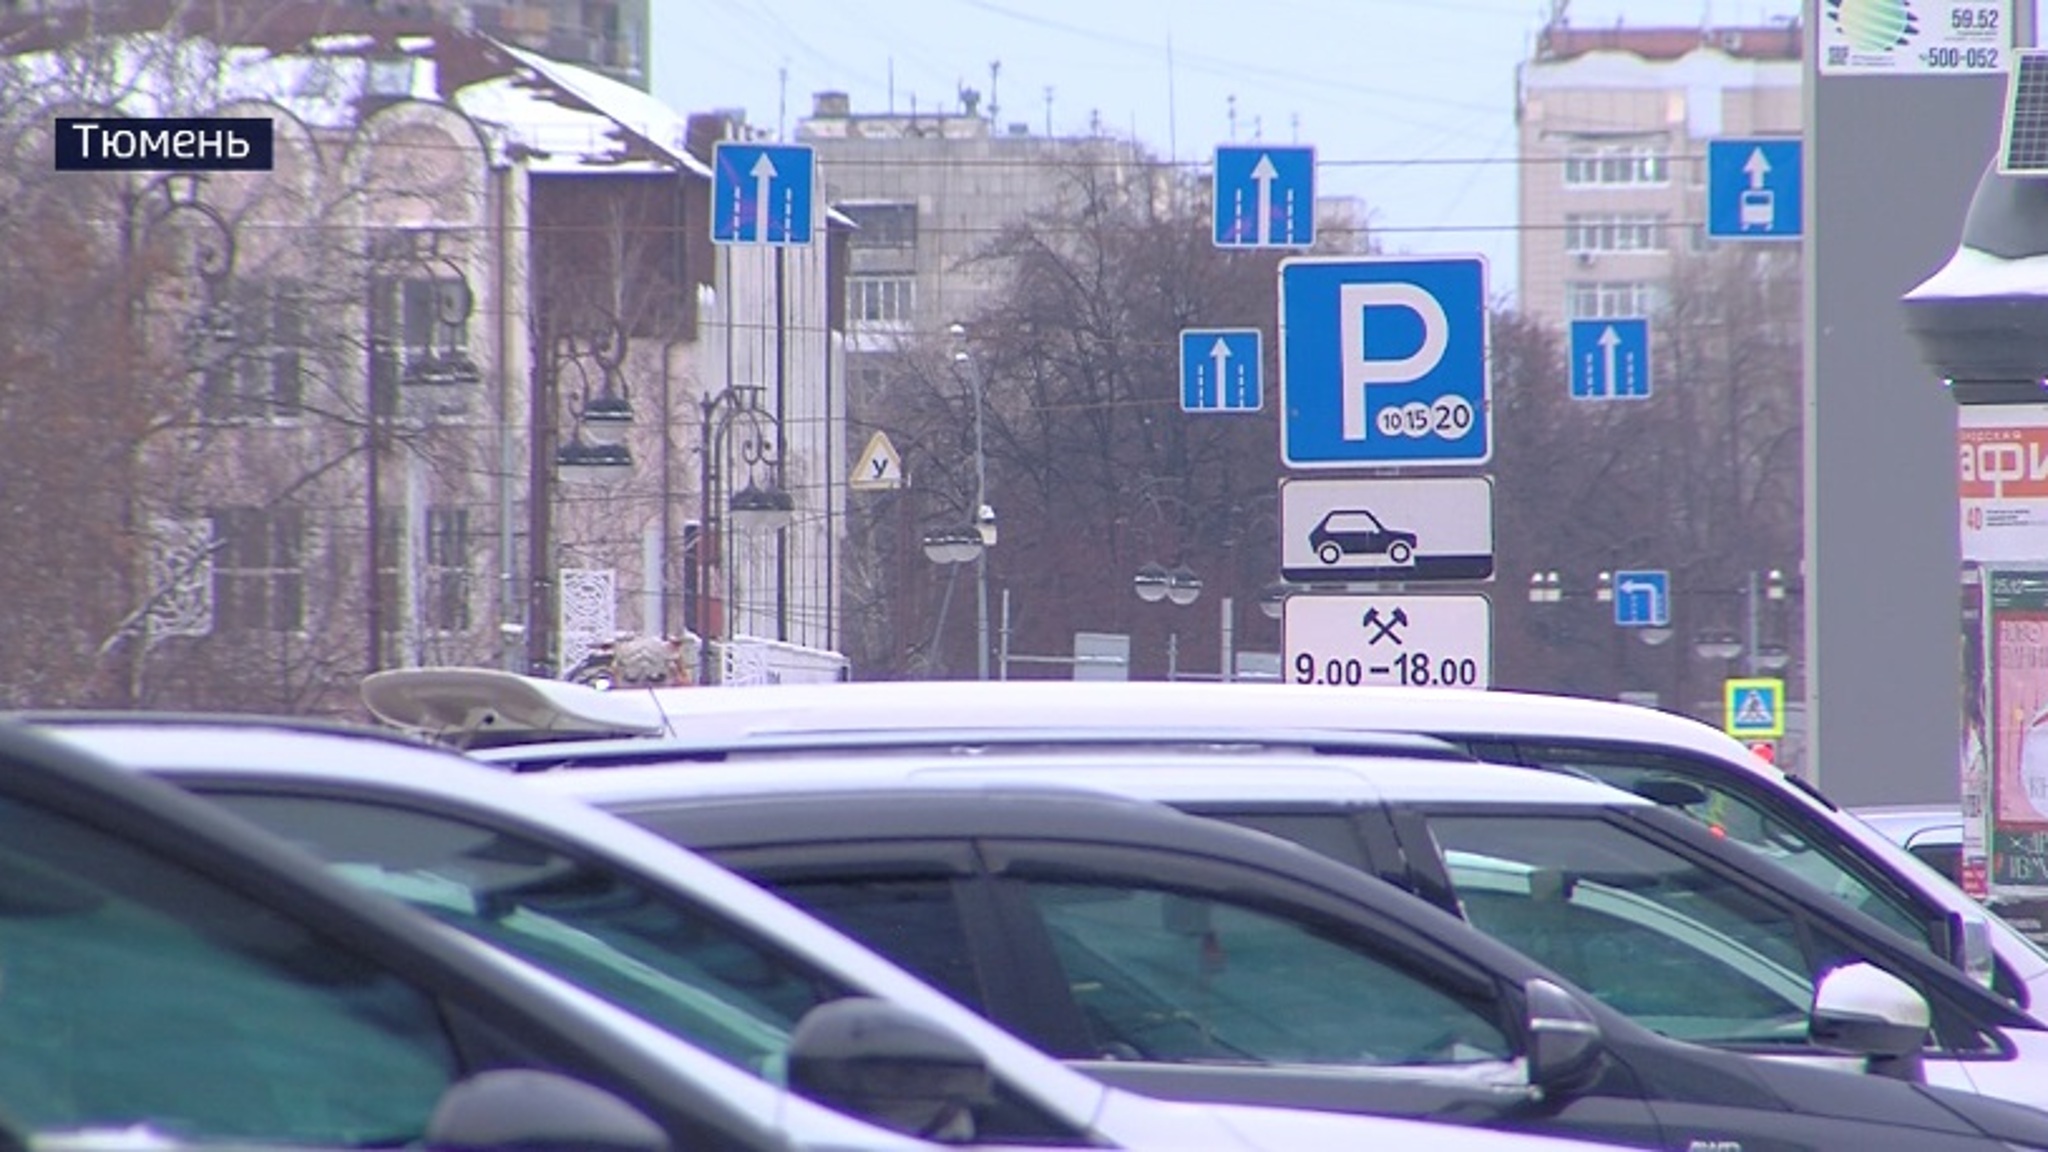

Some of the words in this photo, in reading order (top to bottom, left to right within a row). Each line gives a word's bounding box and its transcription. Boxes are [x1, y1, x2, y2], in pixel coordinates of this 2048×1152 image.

[1928, 47, 1999, 68] 500-052
[1340, 282, 1449, 441] P
[1383, 414, 1402, 430] 10
[1407, 409, 1428, 429] 15
[1435, 404, 1471, 430] 20
